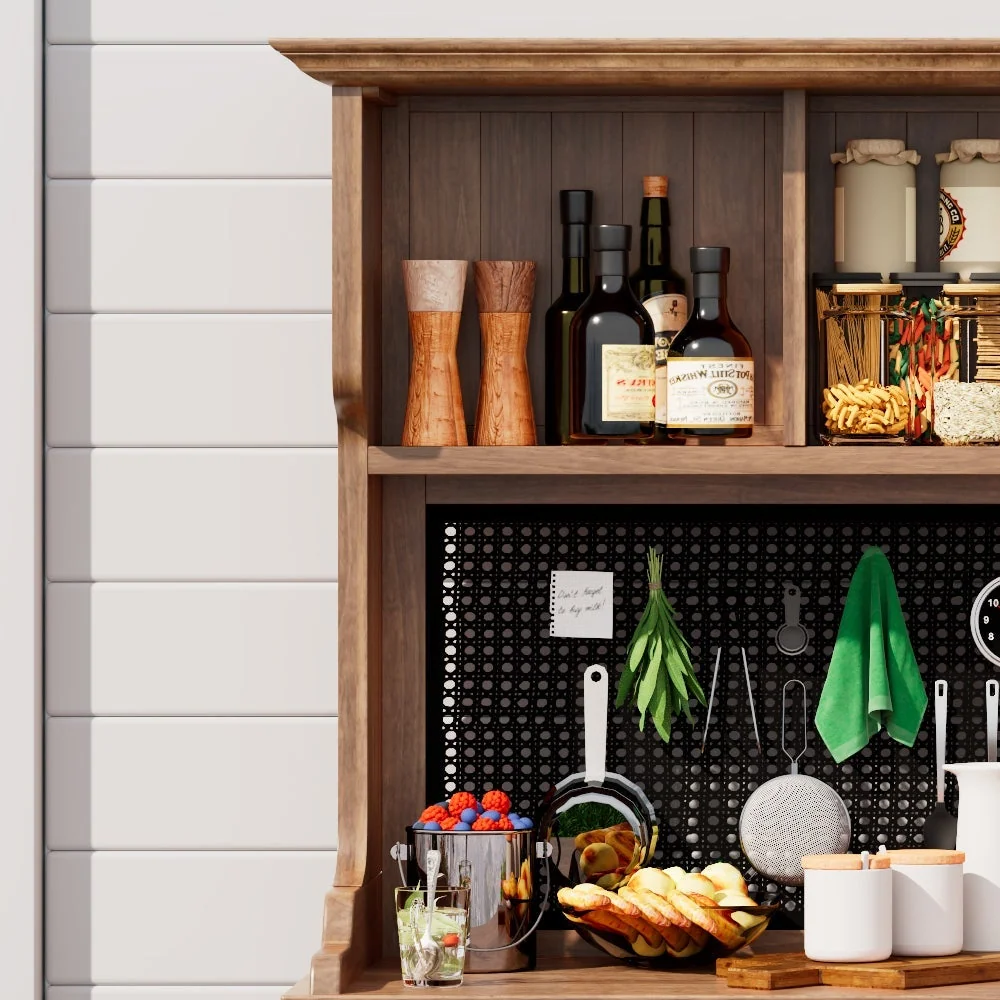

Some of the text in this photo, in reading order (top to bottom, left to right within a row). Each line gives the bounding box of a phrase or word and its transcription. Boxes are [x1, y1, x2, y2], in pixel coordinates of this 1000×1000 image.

[988, 598, 999, 608] 10
[983, 615, 990, 625] 9
[988, 632, 995, 641] 8
